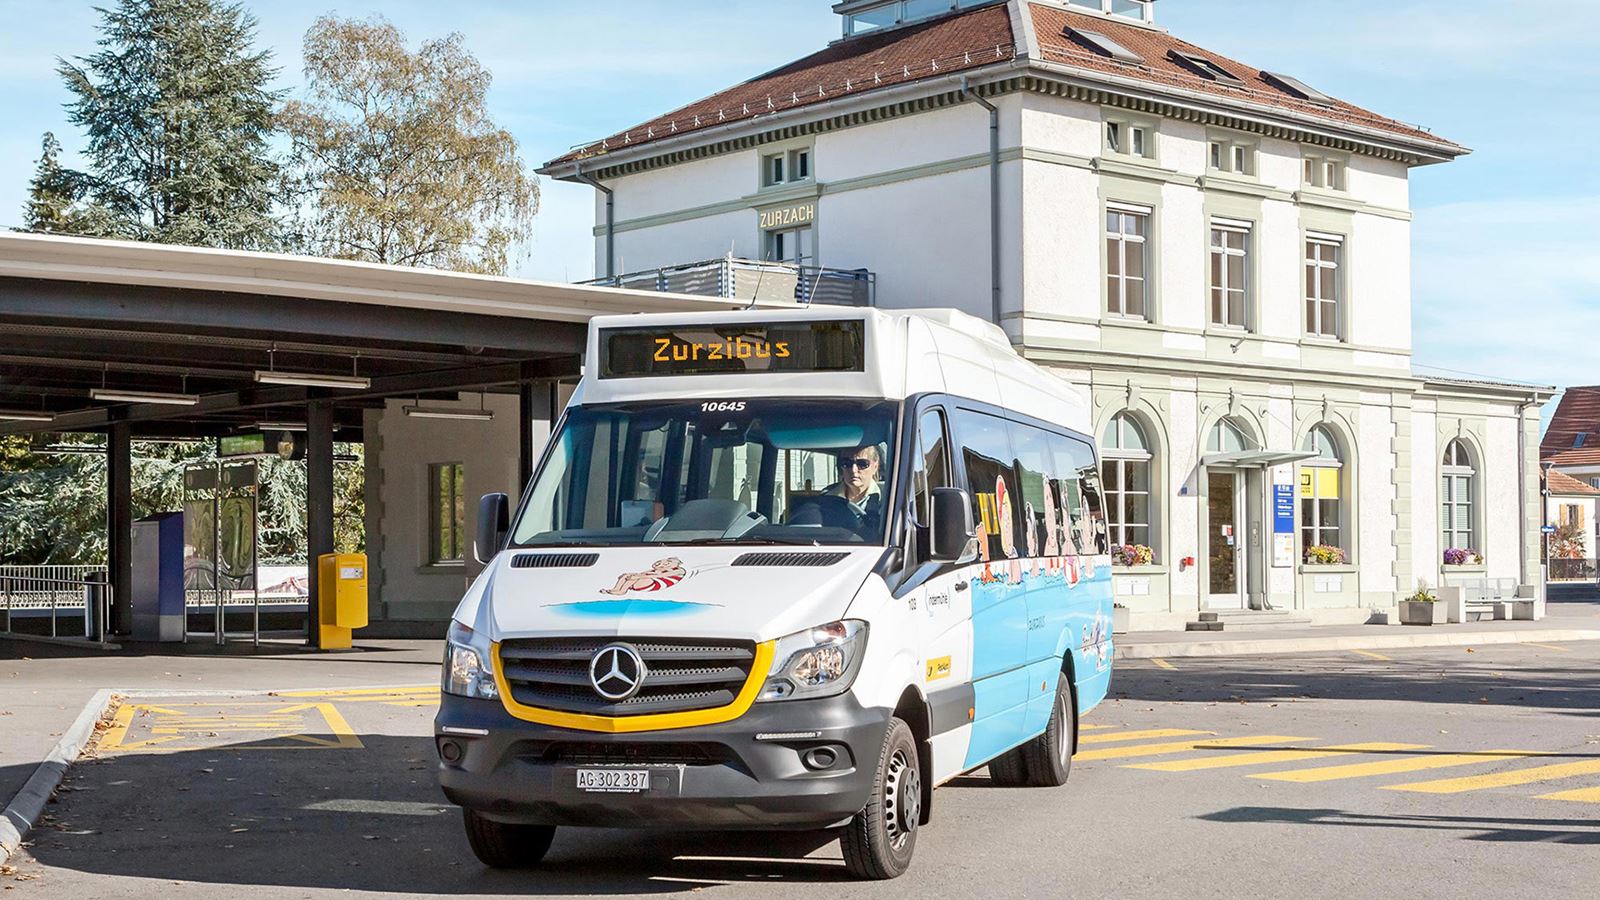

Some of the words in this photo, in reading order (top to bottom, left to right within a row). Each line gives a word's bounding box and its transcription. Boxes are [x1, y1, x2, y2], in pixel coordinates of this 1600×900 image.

[760, 204, 814, 228] ZURZACH
[653, 336, 790, 362] Zurzibus
[701, 401, 746, 412] 10645
